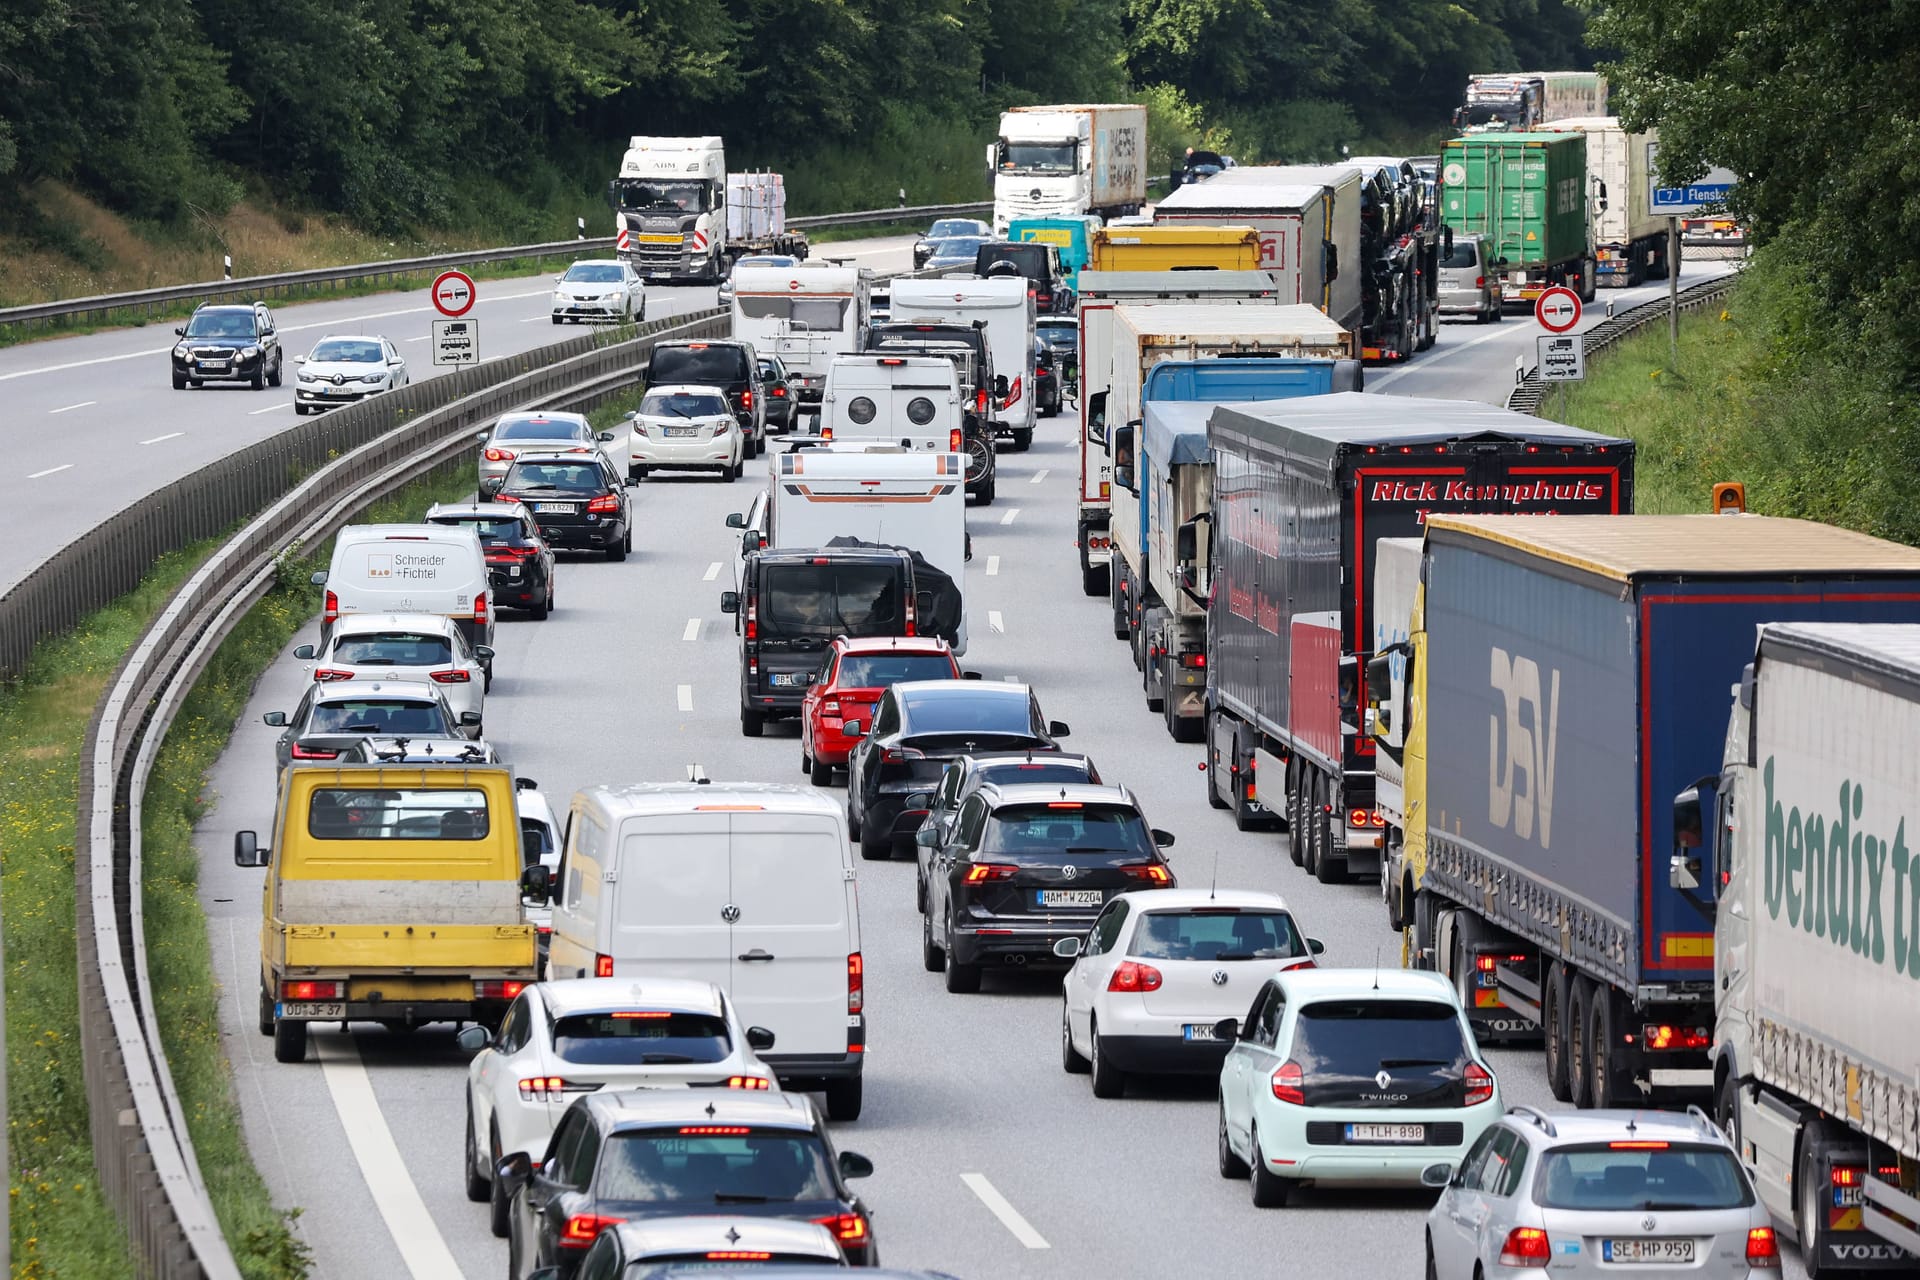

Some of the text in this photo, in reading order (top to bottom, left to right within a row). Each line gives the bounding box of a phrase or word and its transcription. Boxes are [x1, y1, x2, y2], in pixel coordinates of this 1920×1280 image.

[1666, 188, 1730, 201] 7 Flensb
[645, 219, 677, 227] SCANIA
[1371, 480, 1604, 504] Rick Kamphuis
[395, 554, 446, 566] Schneider
[395, 567, 436, 579] +Fichtel
[1489, 647, 1560, 849] DSV
[1763, 754, 1920, 980] bendix tr
[1044, 891, 1101, 903] HAM W 2204
[286, 1004, 341, 1015] OD JF 37
[1483, 1019, 1536, 1031] OLV
[1613, 1242, 1692, 1256] SE HP 959
[1829, 1245, 1906, 1259] VOLV
